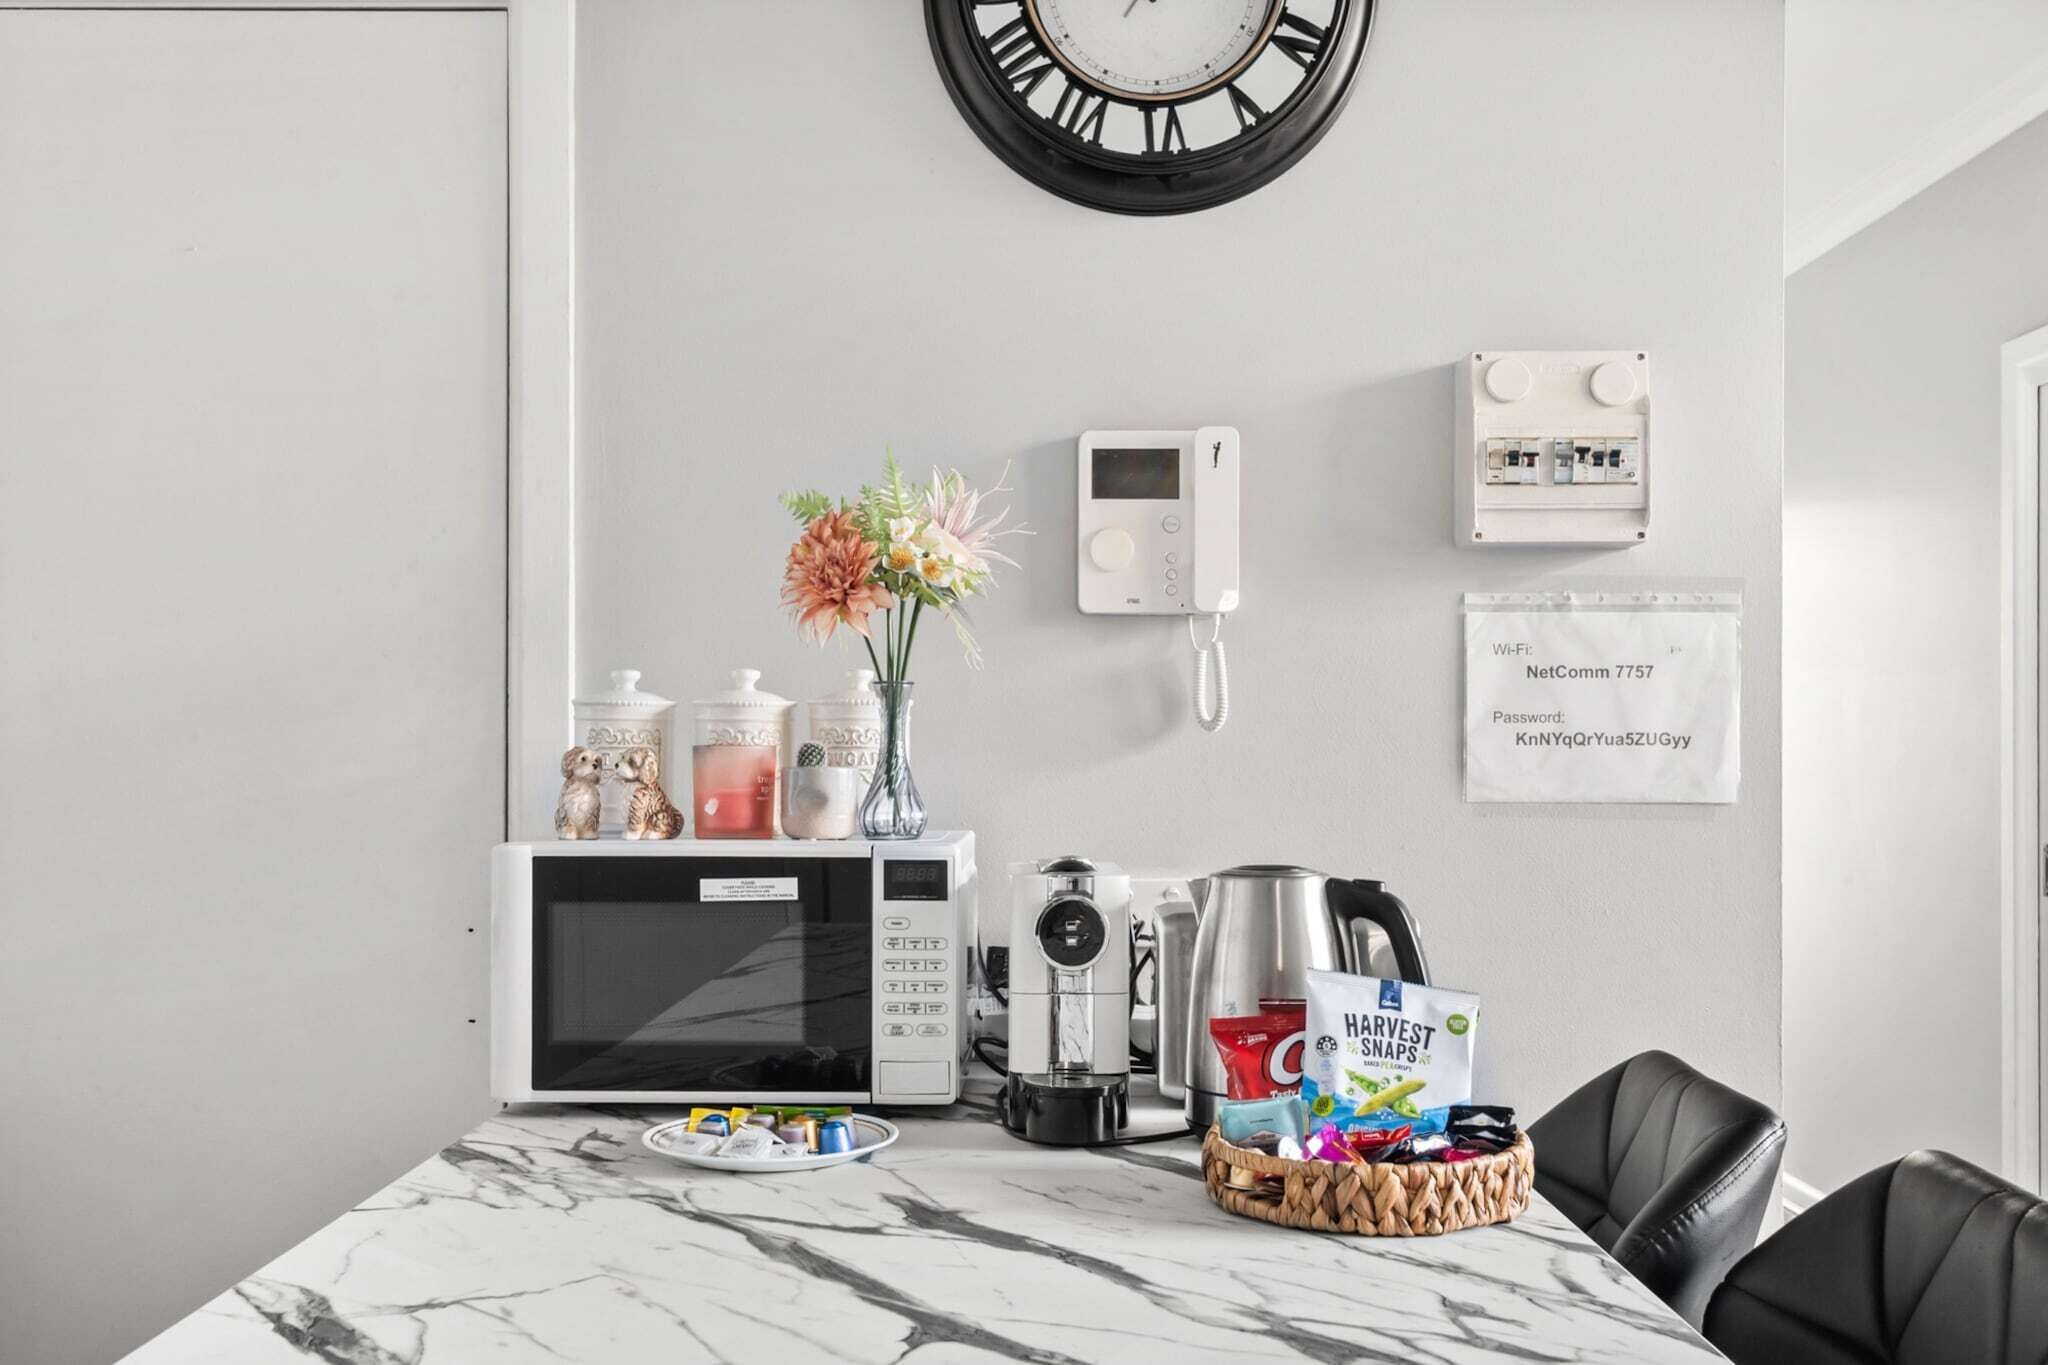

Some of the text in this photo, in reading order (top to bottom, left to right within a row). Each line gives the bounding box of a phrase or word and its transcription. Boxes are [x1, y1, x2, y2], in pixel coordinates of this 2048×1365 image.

[1493, 643, 1533, 656] Wi-Fi:
[1526, 665, 1654, 679] NetComm 7757
[1493, 711, 1565, 724] Password:
[1515, 732, 1691, 749] KnNYqQrYua5ZUGyy
[1344, 1013, 1436, 1050] HARVEST
[1361, 1037, 1418, 1063] SNAPS
